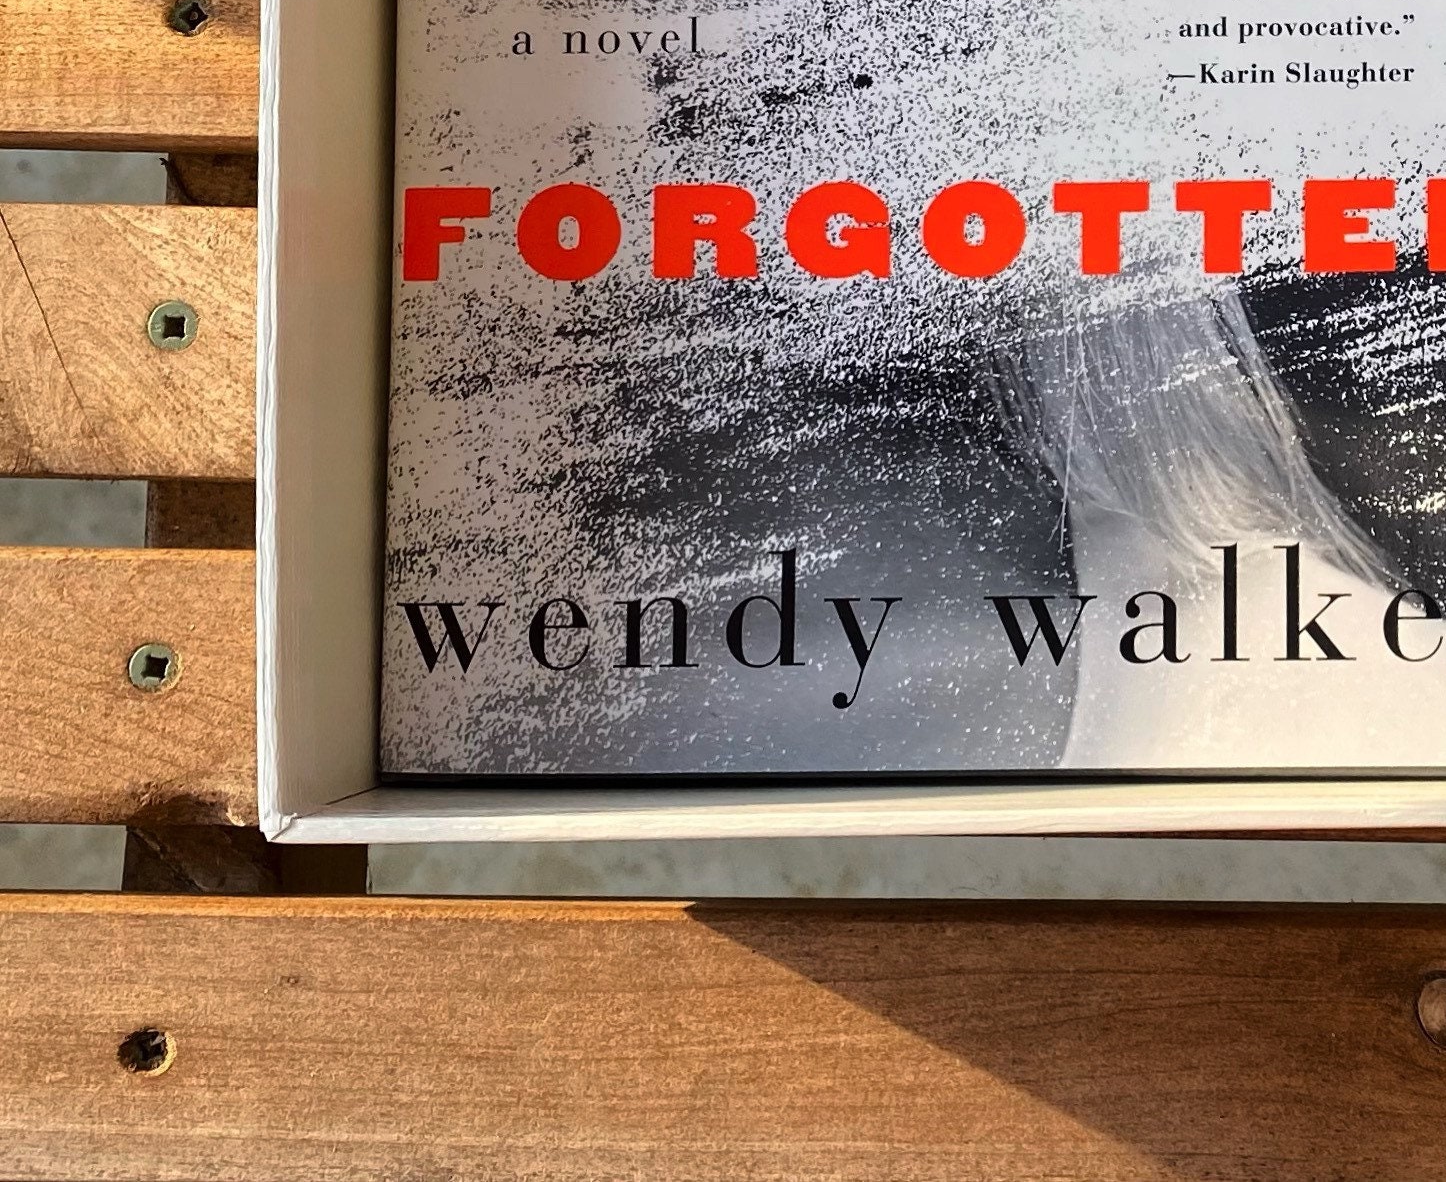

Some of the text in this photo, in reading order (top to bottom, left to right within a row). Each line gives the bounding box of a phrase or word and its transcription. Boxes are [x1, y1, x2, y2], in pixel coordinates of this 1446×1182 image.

[511, 16, 700, 55] a novel
[1179, 14, 1415, 44] and provocative.”
[1285, 61, 1415, 89] Slaughter
[403, 550, 903, 710] wendy
